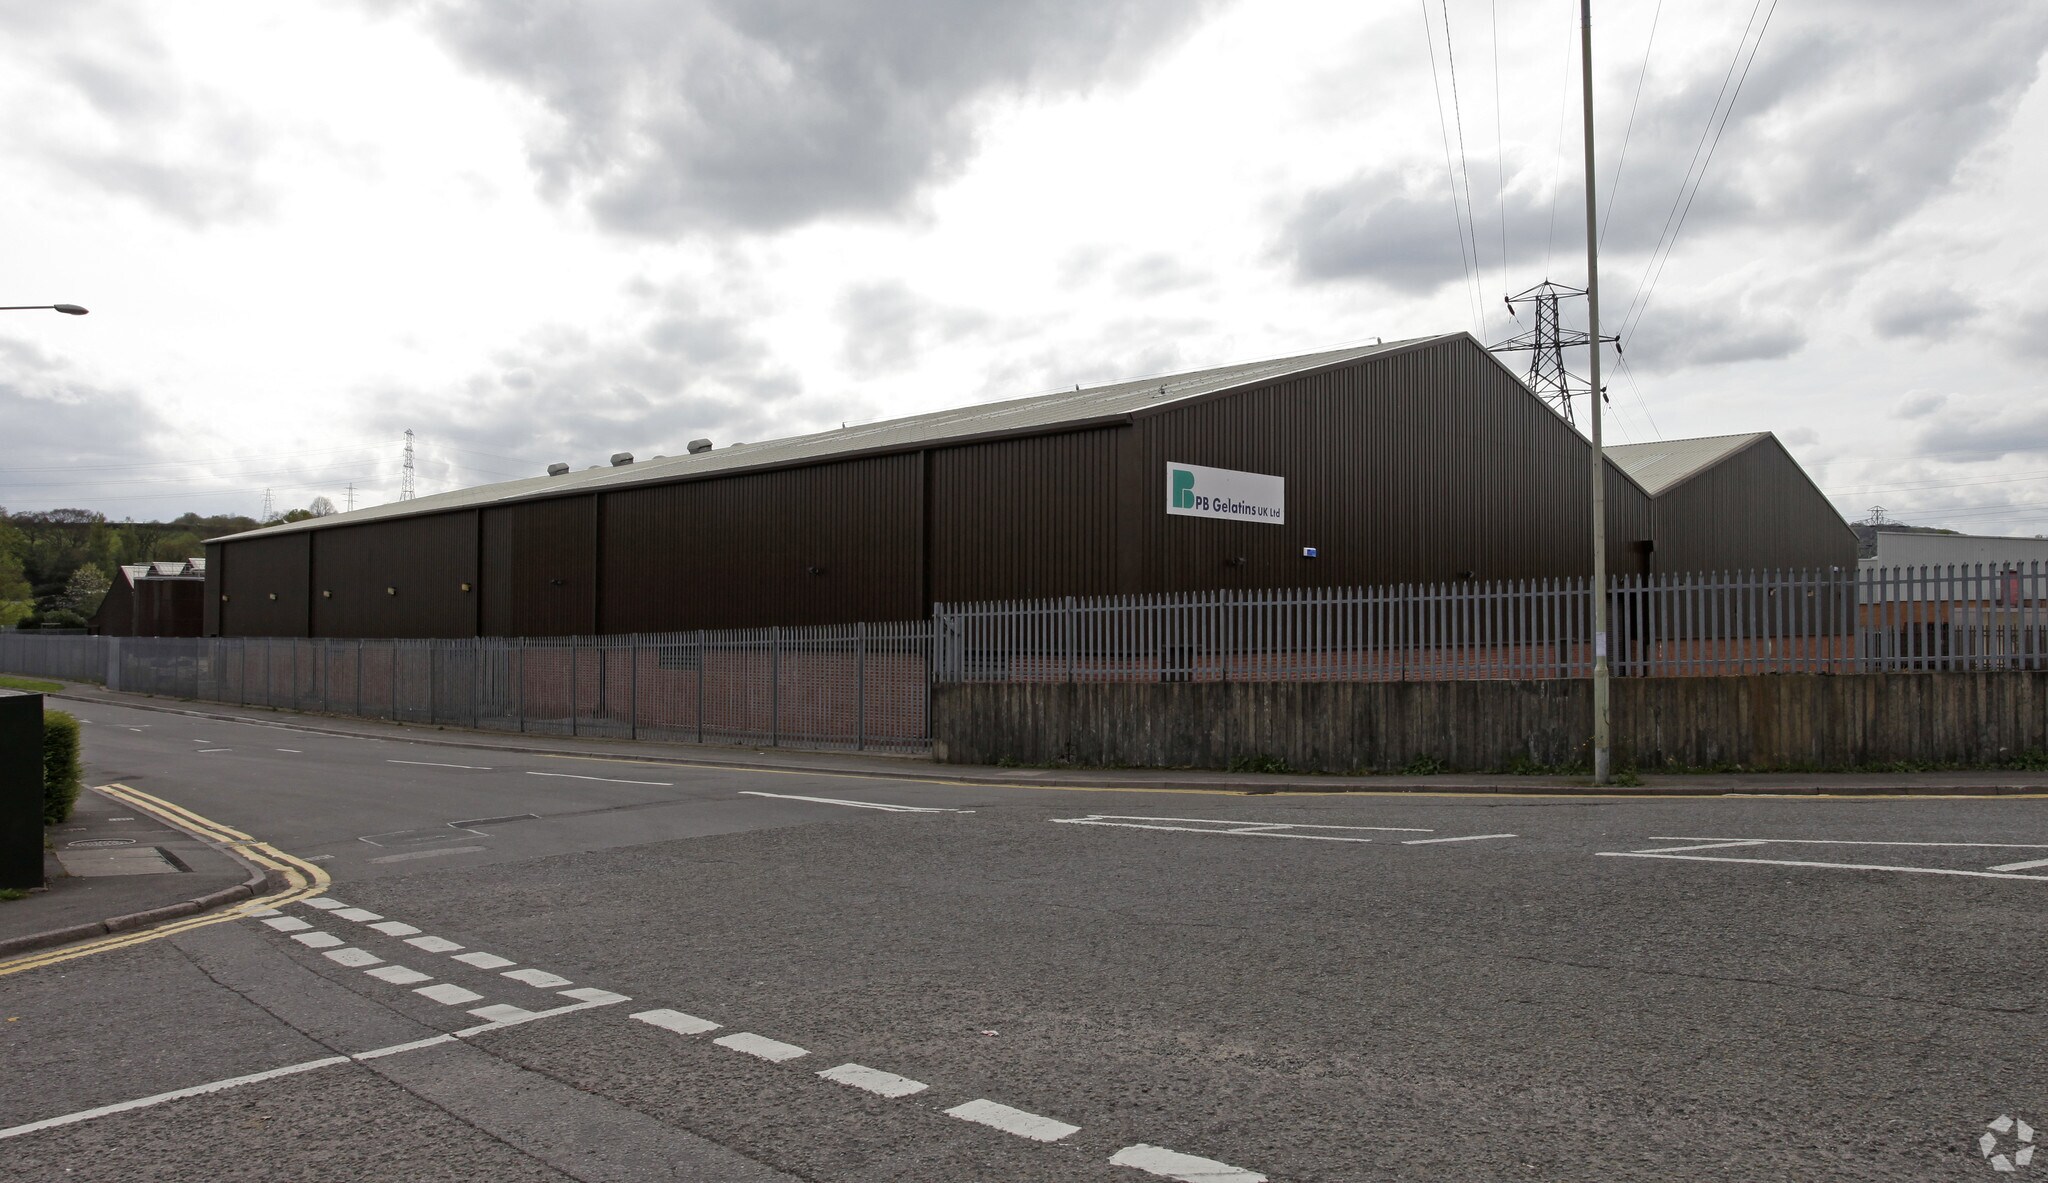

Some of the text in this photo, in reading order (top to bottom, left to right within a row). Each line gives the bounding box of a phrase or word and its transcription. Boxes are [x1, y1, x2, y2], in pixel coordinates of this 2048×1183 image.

[1195, 496, 1281, 518] PB Gelatins UK Ltd
